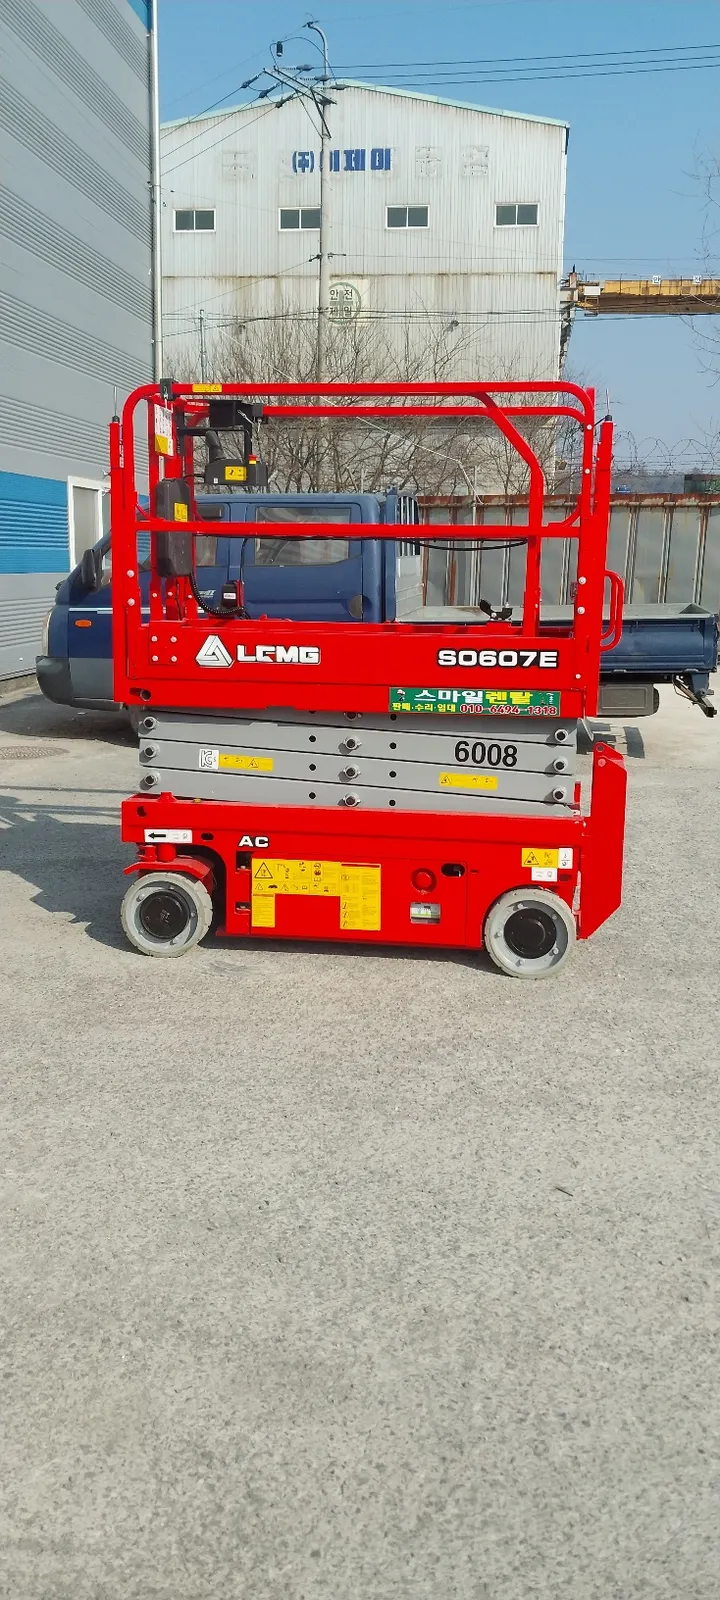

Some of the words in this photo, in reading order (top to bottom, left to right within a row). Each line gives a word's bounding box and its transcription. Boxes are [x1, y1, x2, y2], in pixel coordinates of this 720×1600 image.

[414, 689, 533, 705] 스마일렌탈
[460, 703, 557, 715] 010-6494-1318
[454, 740, 518, 767] 6008
[238, 835, 269, 848] AC
